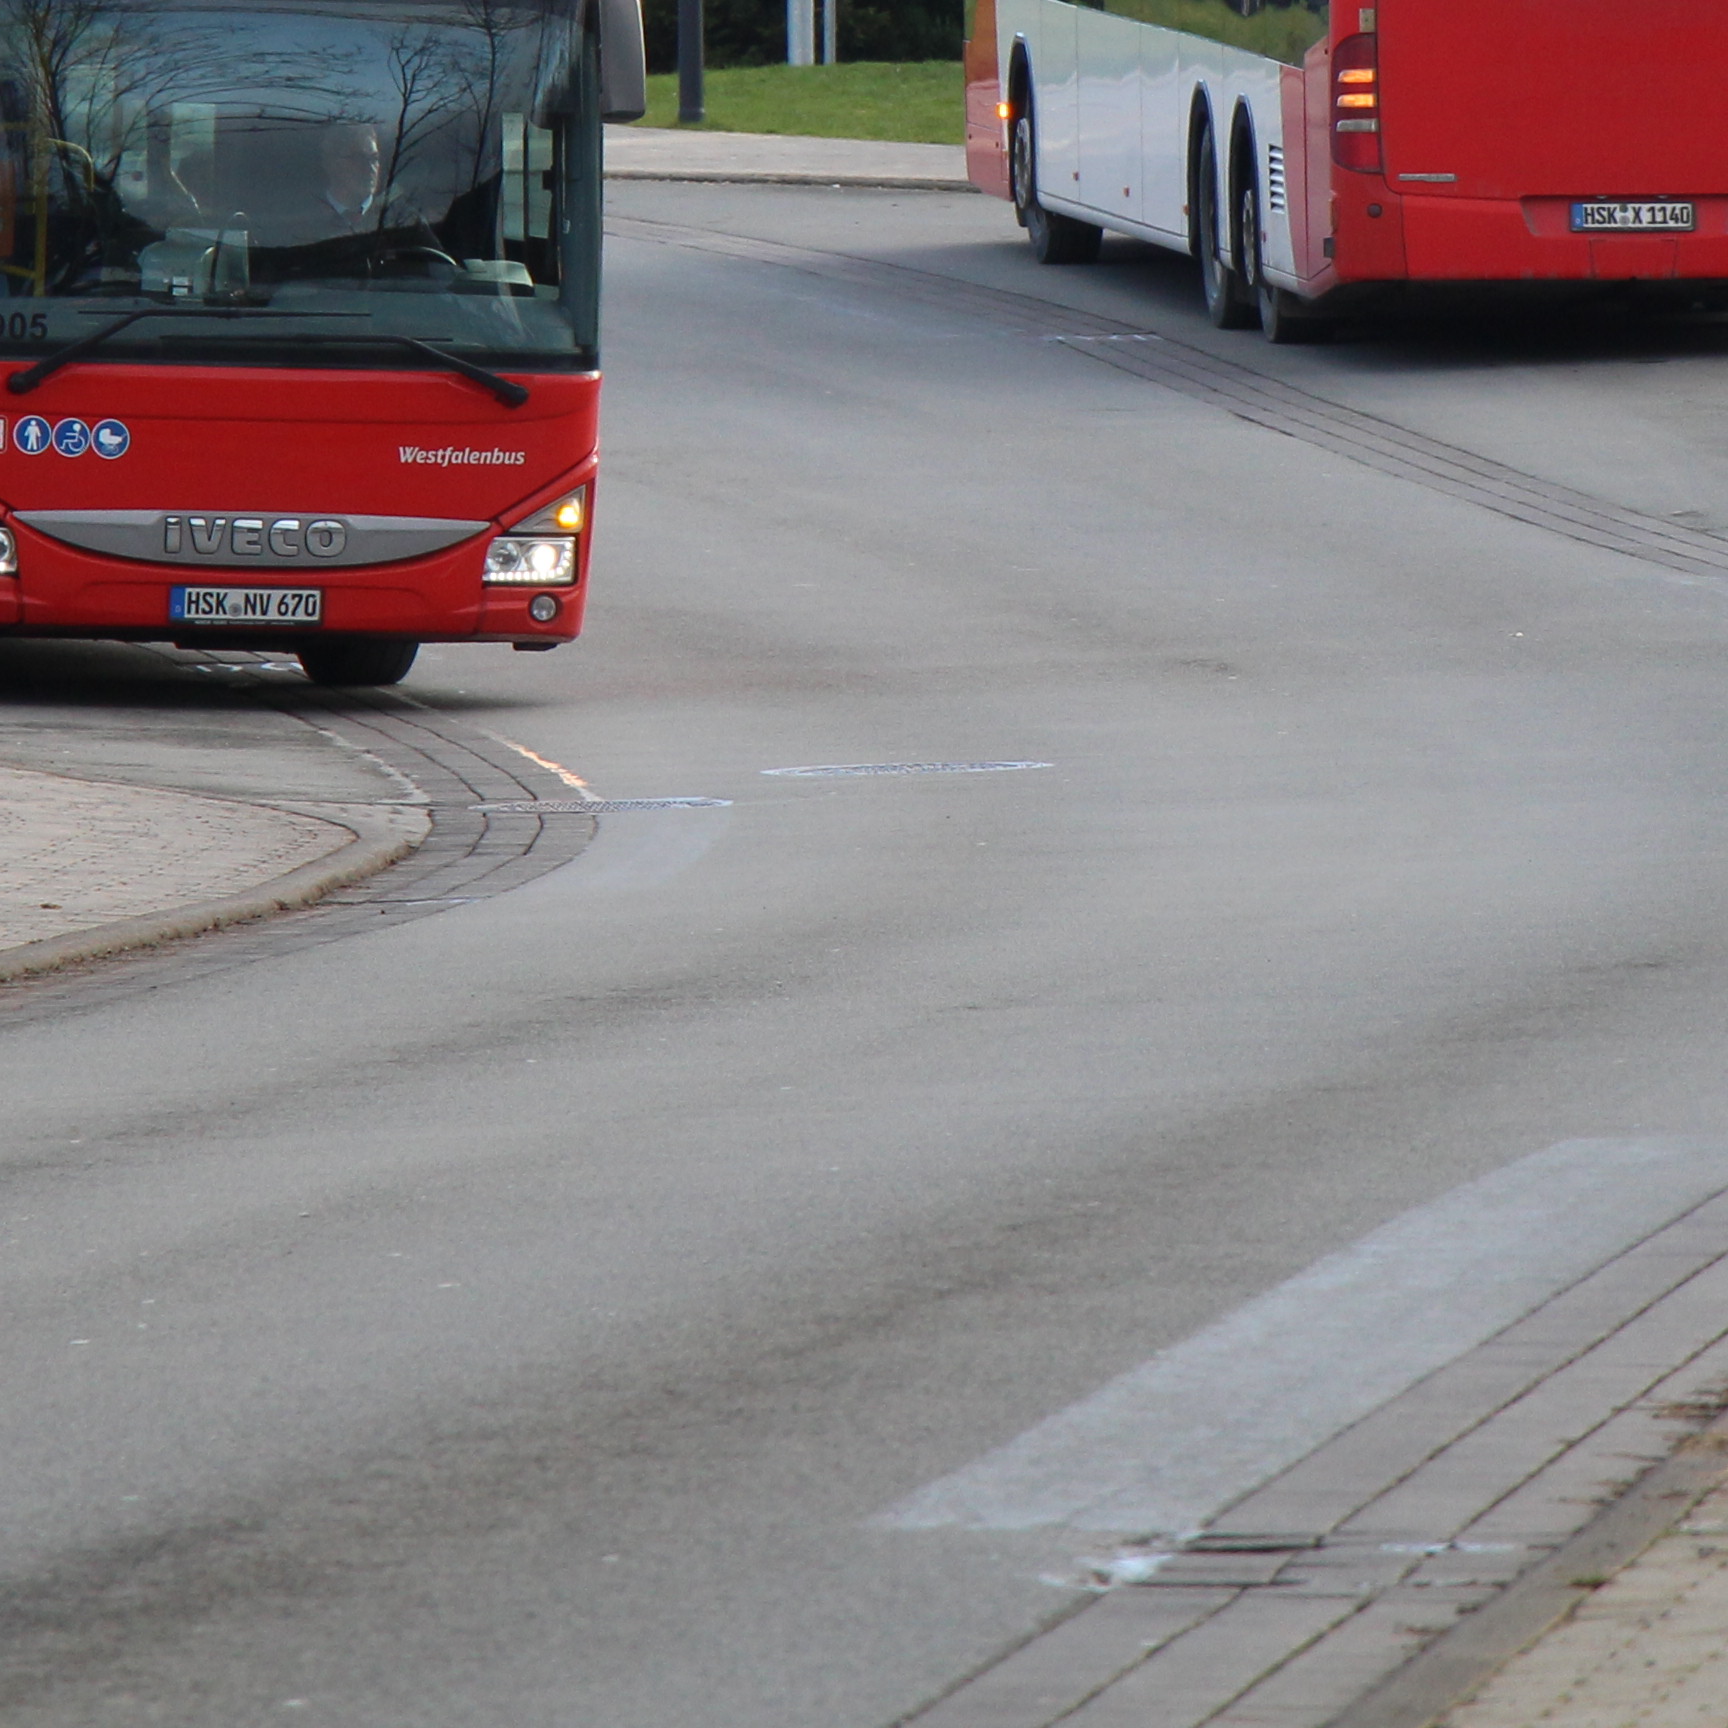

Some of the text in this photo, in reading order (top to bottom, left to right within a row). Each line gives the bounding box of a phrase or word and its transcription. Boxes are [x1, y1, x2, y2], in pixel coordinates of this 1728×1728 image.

[1583, 206, 1691, 225] HSK X 1140
[398, 446, 526, 467] Westfalenbus
[186, 591, 318, 617] HSK NV 670
